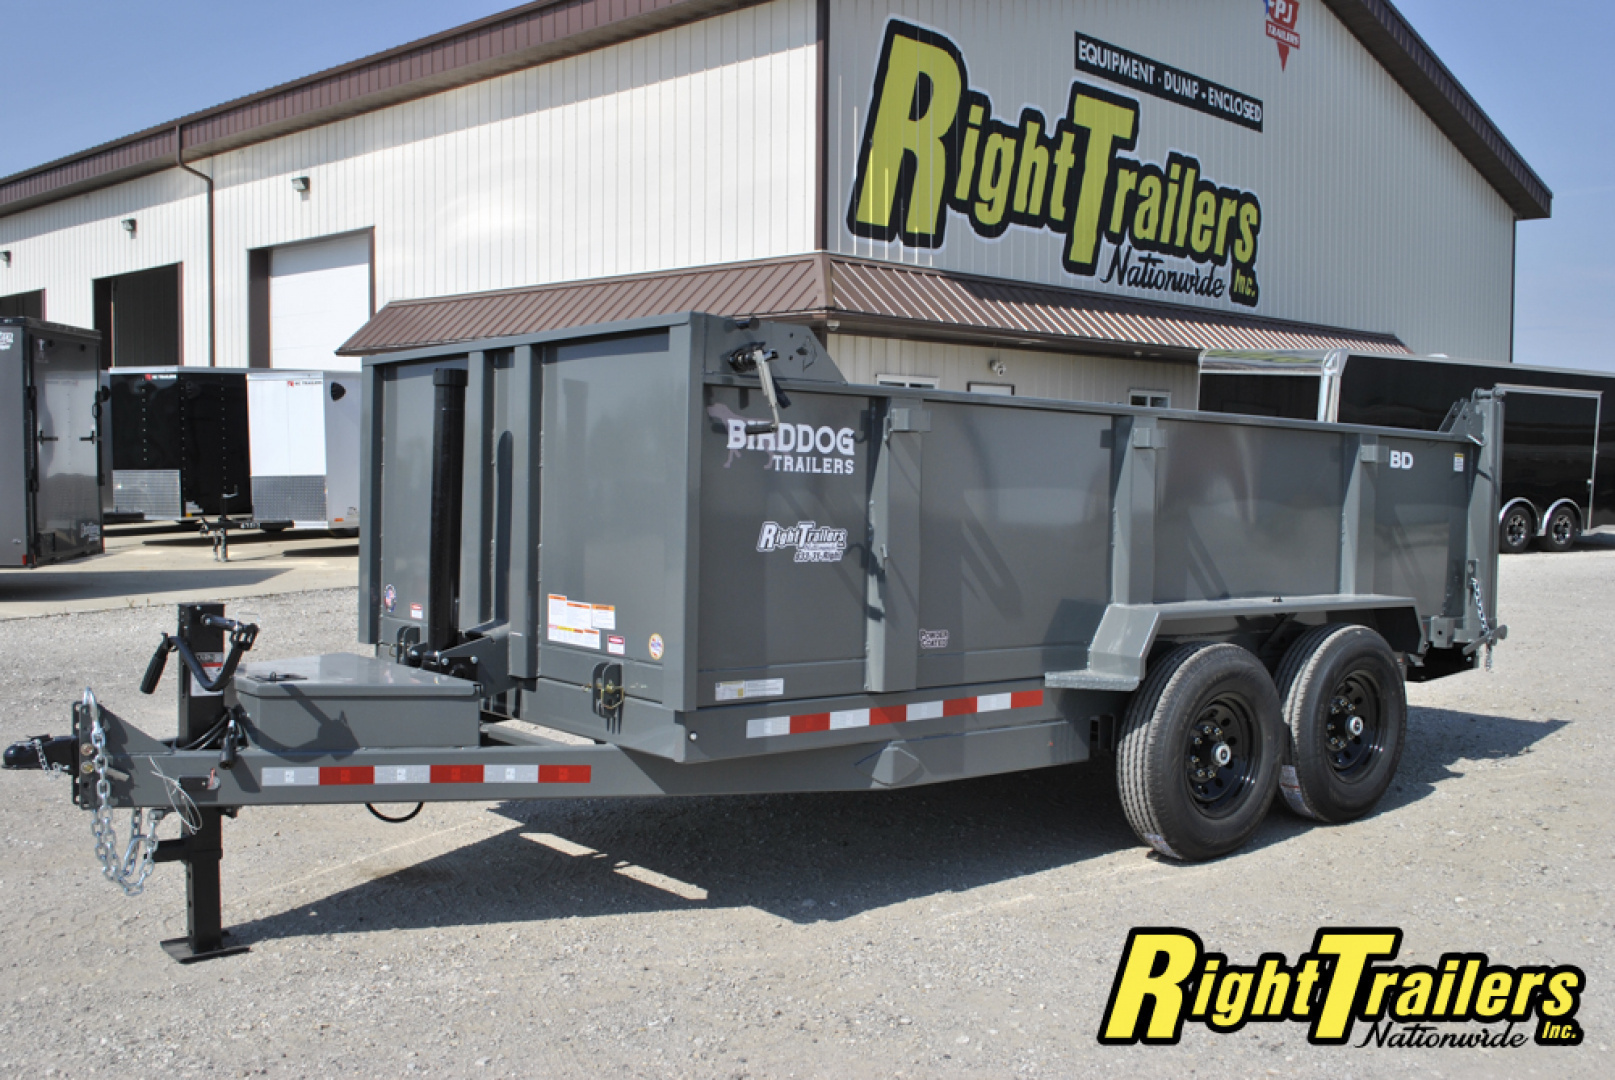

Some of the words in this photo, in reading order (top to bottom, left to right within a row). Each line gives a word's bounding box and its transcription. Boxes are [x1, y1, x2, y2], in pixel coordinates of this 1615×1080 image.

[1077, 38, 1156, 85] EQUIPMENT
[1163, 70, 1199, 100] DUMP
[1207, 86, 1262, 122] ENCLOSED
[1100, 244, 1226, 298] Nationwide
[1233, 267, 1256, 299] Inc.
[772, 455, 855, 475] TRAILERS
[1389, 449, 1414, 469] BD
